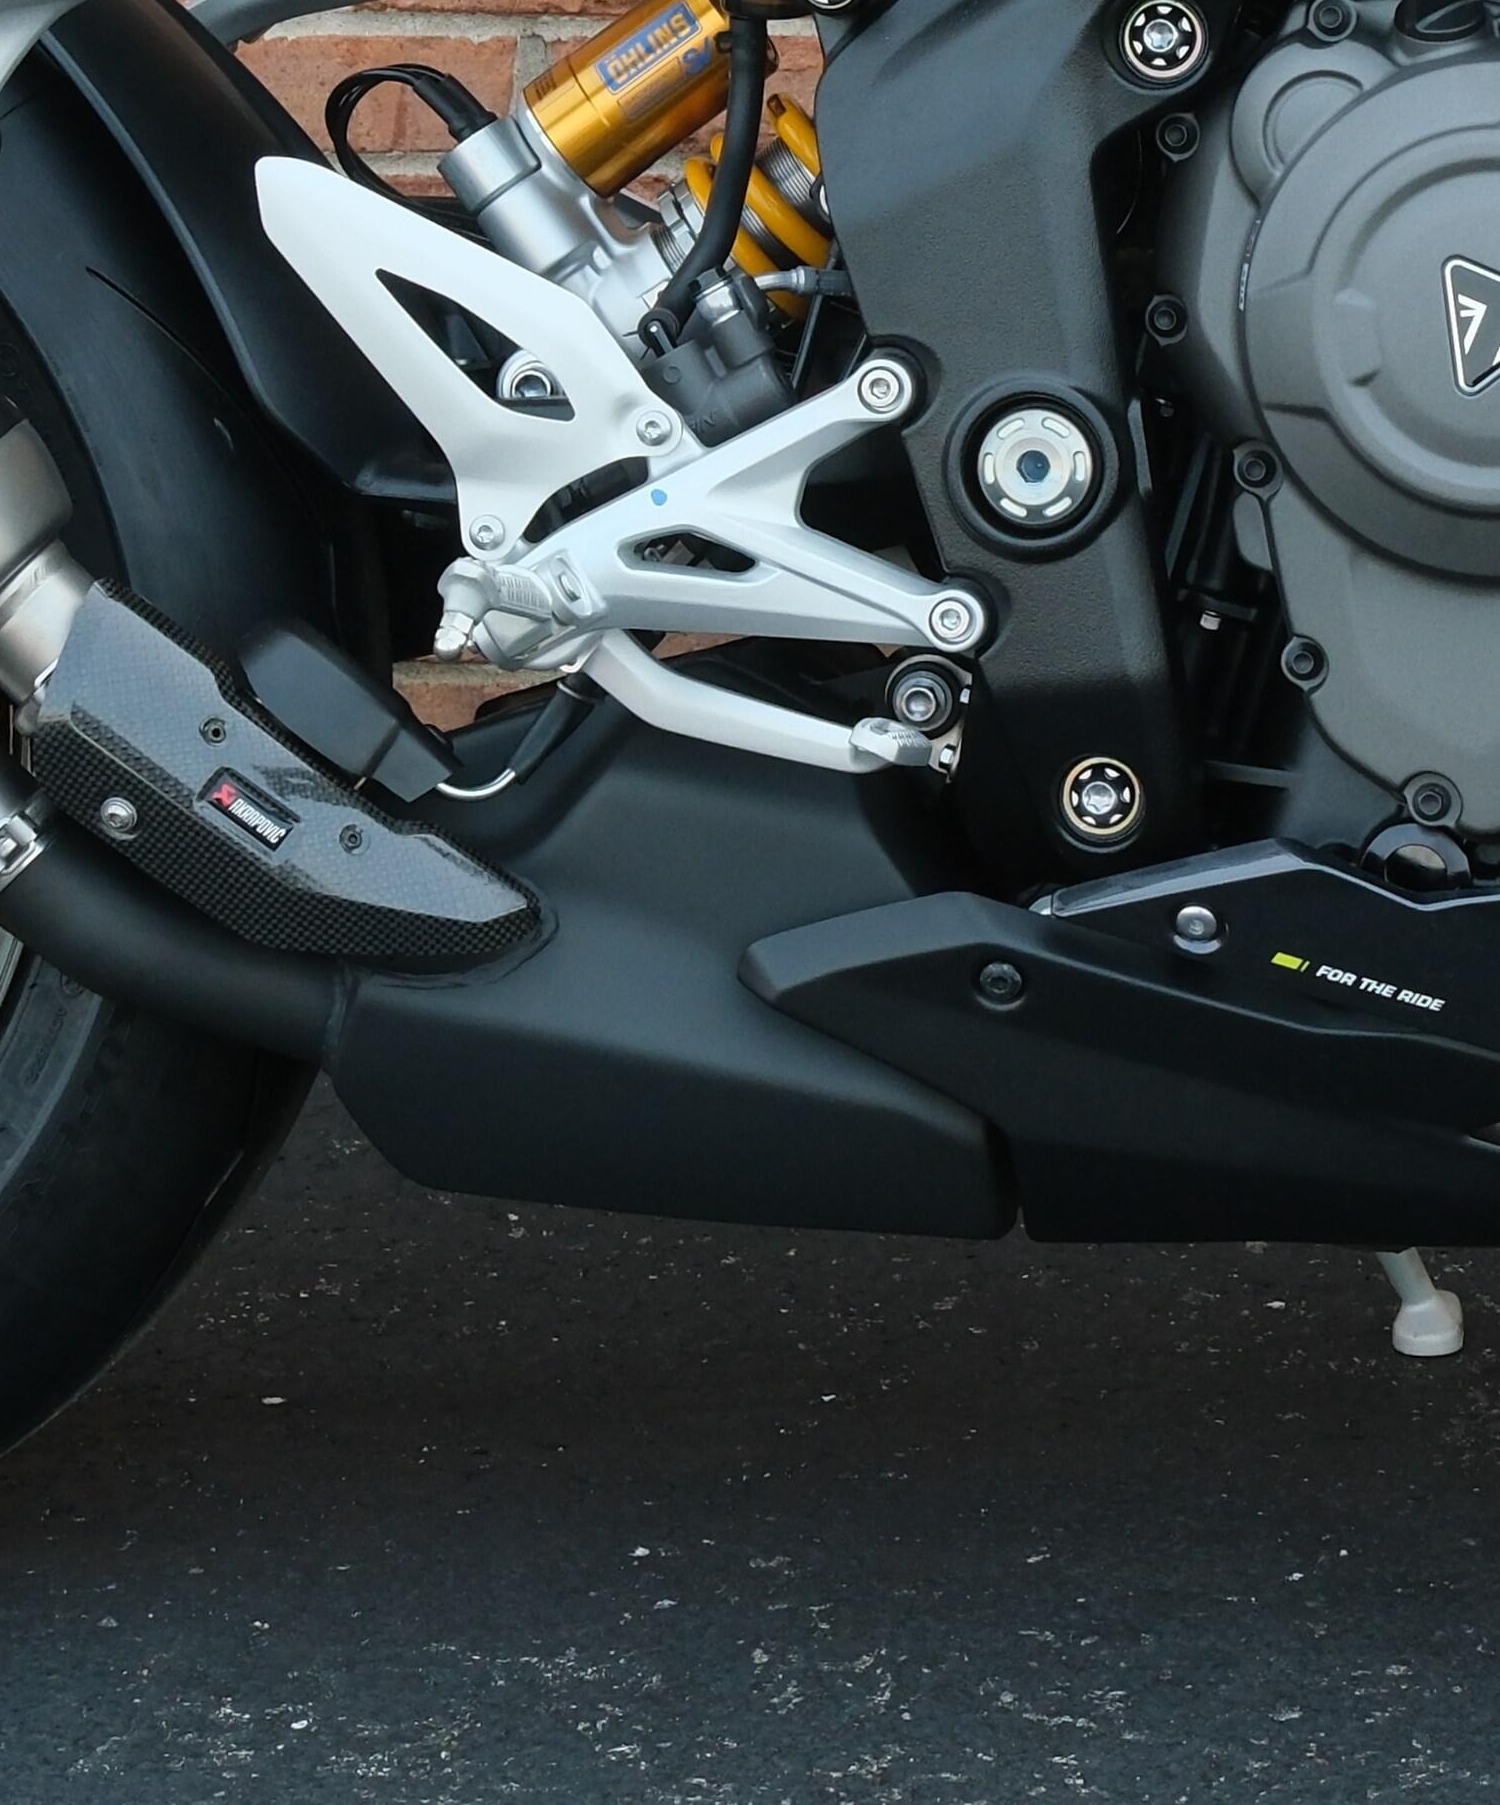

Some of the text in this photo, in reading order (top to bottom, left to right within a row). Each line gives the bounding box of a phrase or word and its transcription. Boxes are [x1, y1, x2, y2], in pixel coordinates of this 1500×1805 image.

[602, 12, 693, 84] ÖHLINS
[1315, 965, 1446, 1012] FOR THE RIDE
